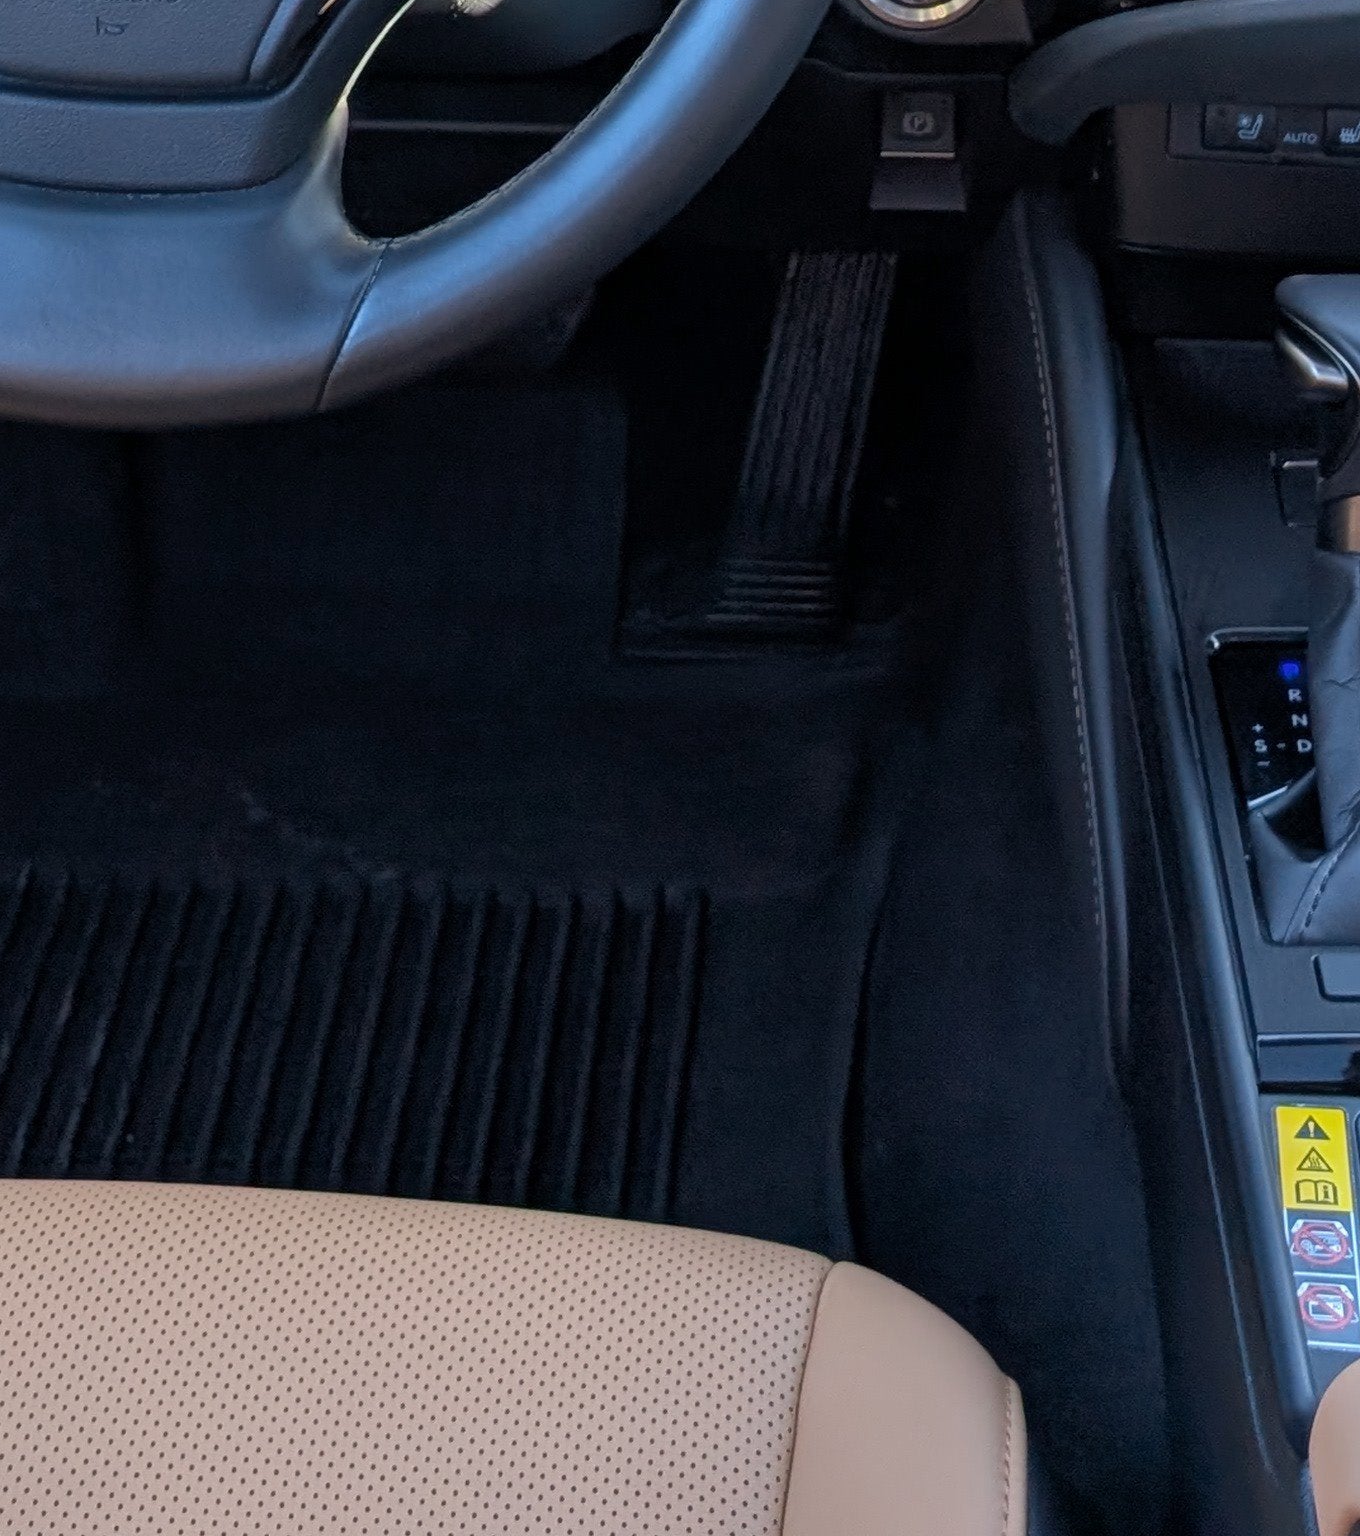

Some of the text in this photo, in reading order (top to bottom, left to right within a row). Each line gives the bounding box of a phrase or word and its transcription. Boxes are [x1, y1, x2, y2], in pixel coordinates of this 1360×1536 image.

[1283, 132, 1318, 145] AUTO
[1287, 688, 1302, 703] R
[1291, 713, 1309, 727] N
[1254, 738, 1313, 753] S D
